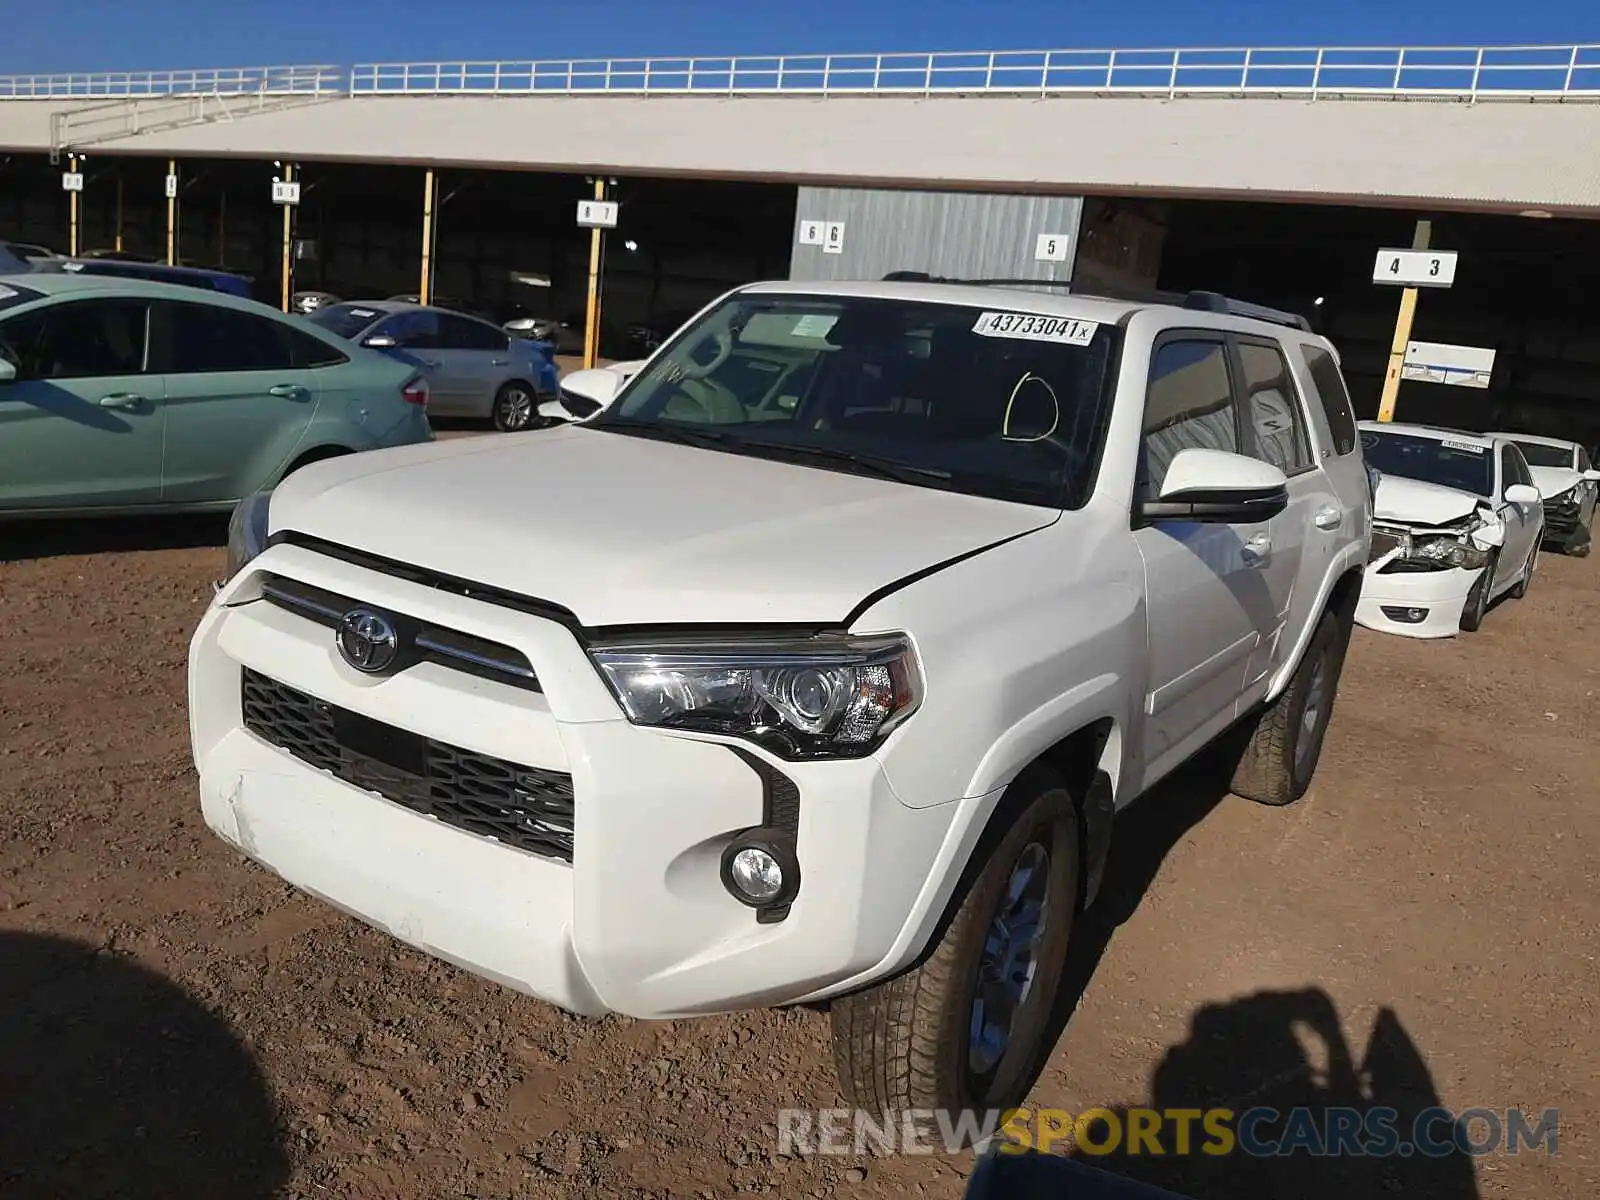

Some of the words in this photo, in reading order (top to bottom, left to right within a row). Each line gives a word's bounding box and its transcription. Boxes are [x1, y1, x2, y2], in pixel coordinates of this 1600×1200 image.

[809, 226, 816, 240] 6
[1047, 240, 1056, 255] 5
[1390, 258, 1401, 274] 4
[1429, 259, 1441, 276] 3
